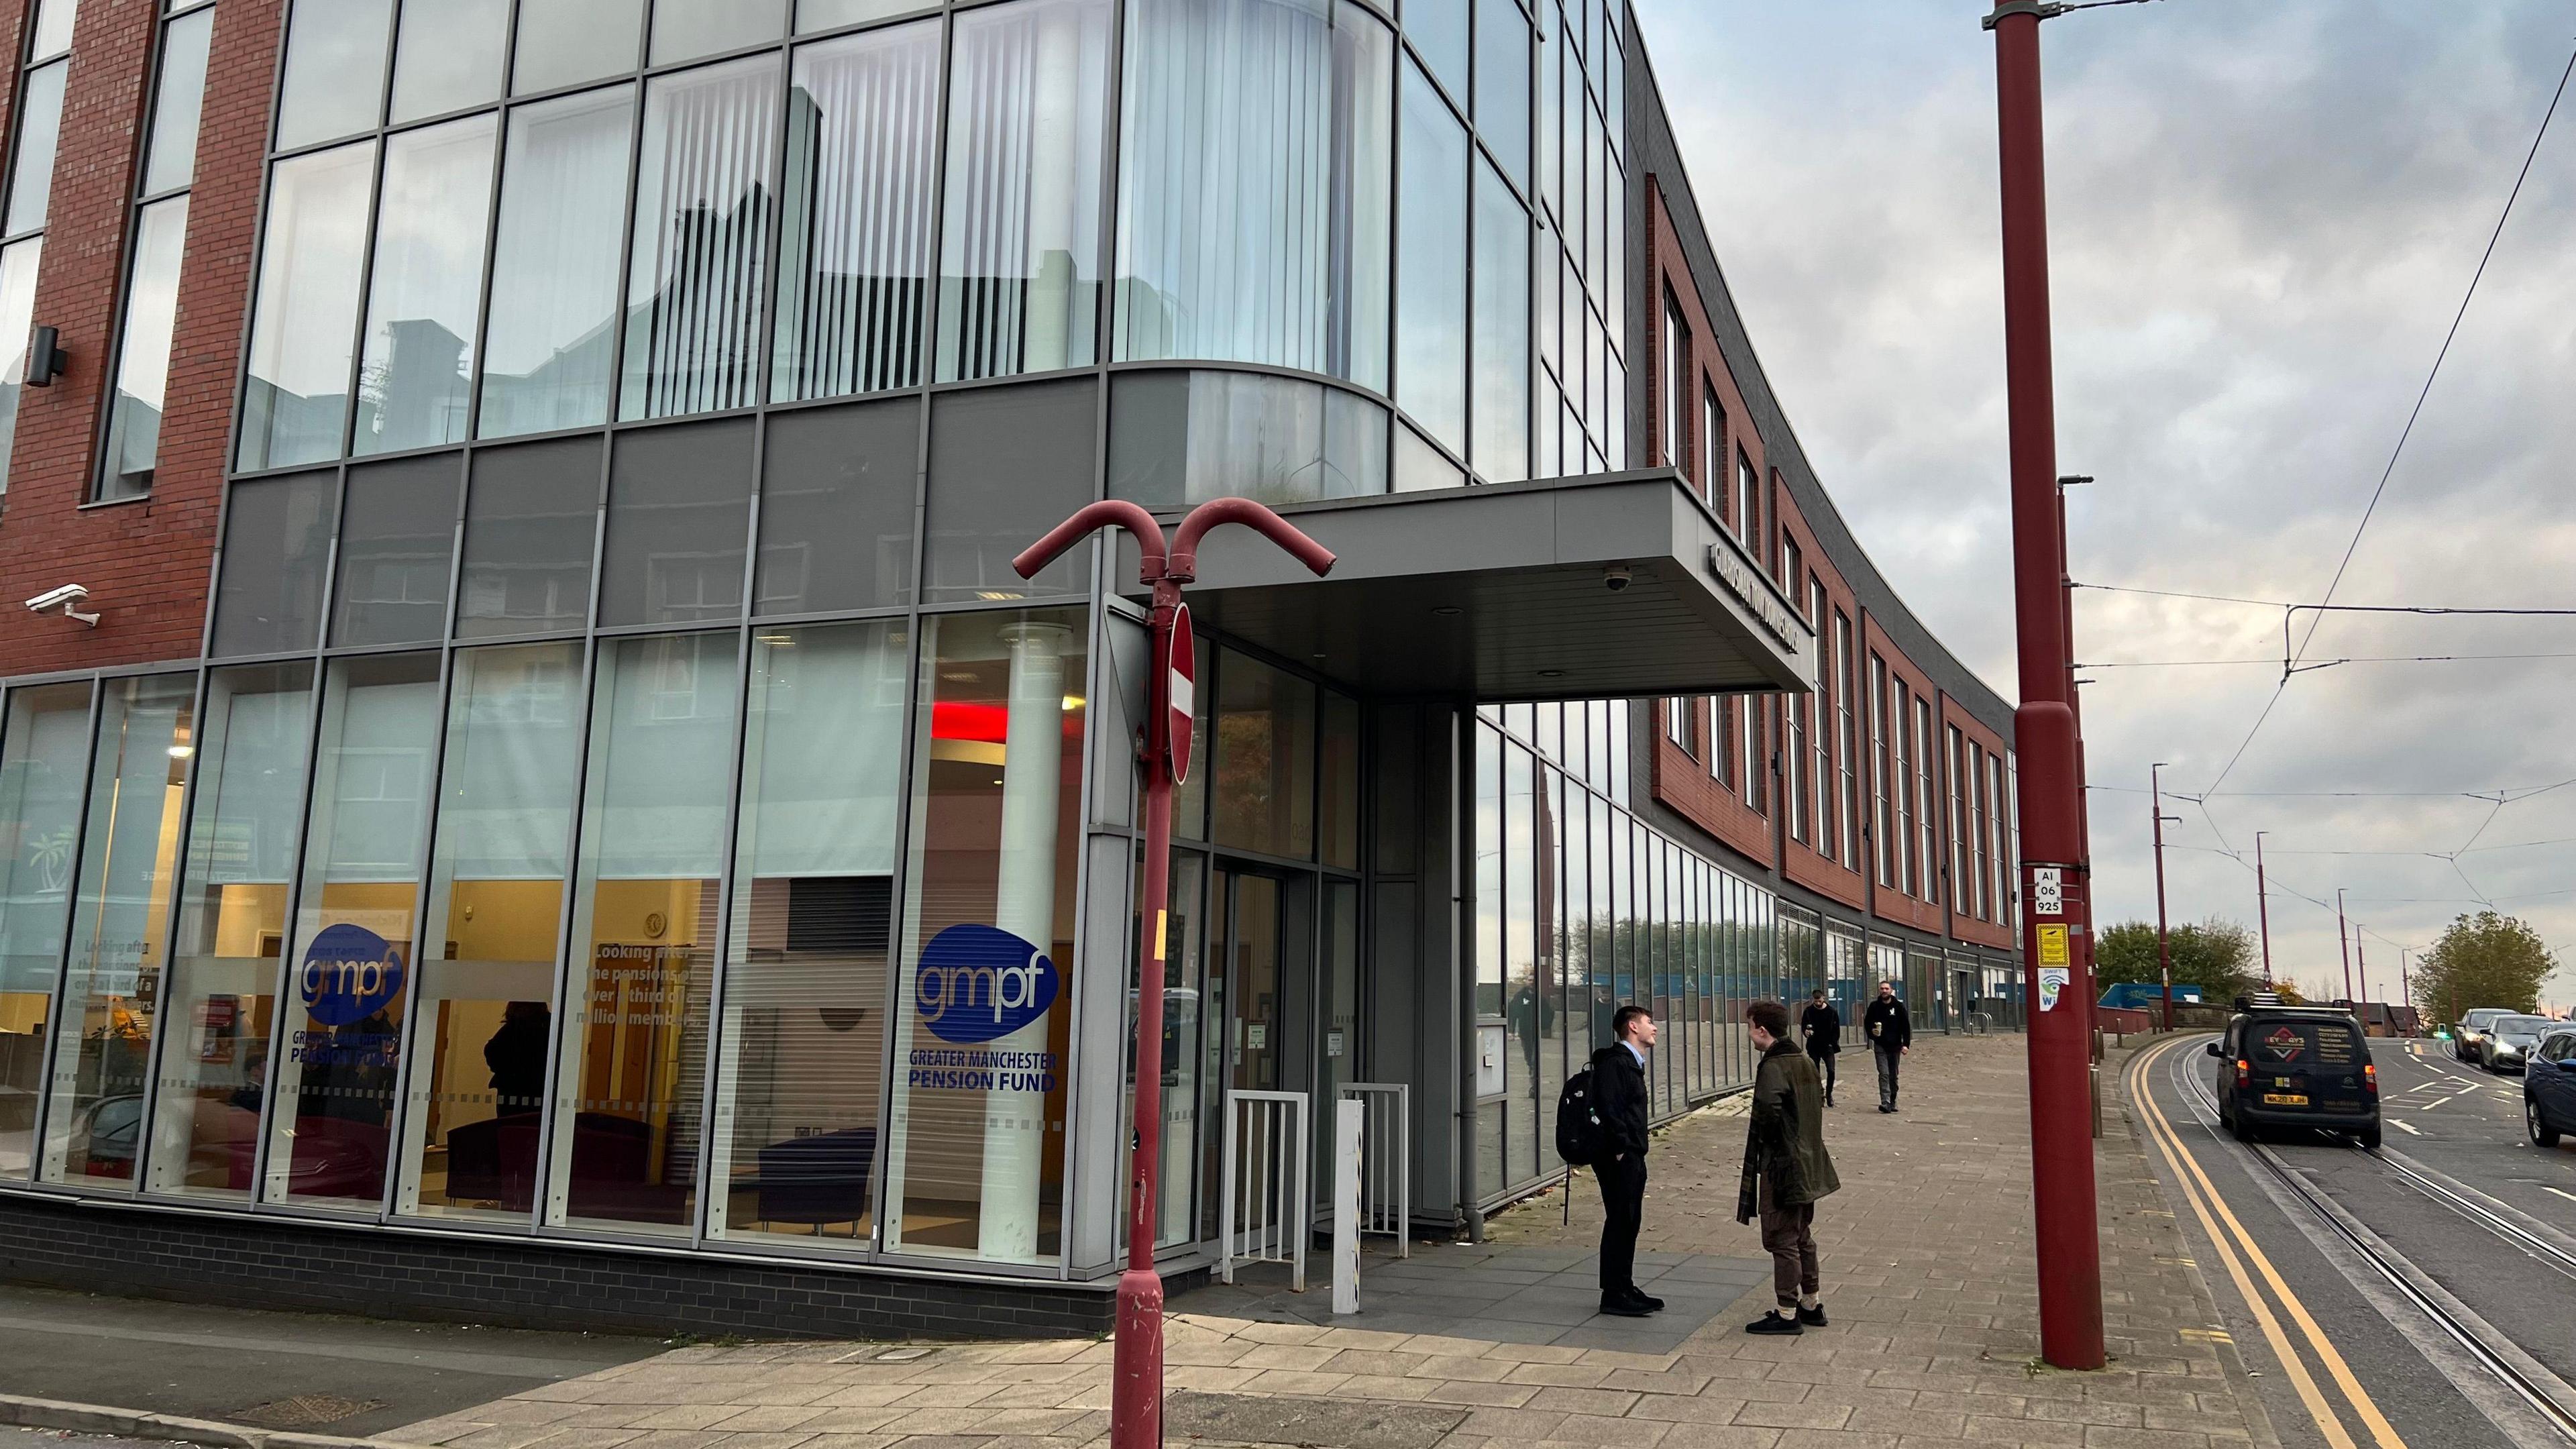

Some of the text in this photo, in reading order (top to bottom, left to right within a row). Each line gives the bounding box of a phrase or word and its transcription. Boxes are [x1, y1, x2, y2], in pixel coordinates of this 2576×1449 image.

[1713, 543, 1752, 605] GUARDSMAN
[2041, 886, 2055, 896] 06
[2038, 902, 2059, 912] 925
[595, 945, 651, 962] Looking
[303, 947, 394, 1008] gmpf
[916, 950, 1044, 1023] gmpf
[629, 987, 664, 1004] third
[909, 1050, 1057, 1069] GREATER MANCHESTER
[908, 1069, 1056, 1092] PENSION FUND
